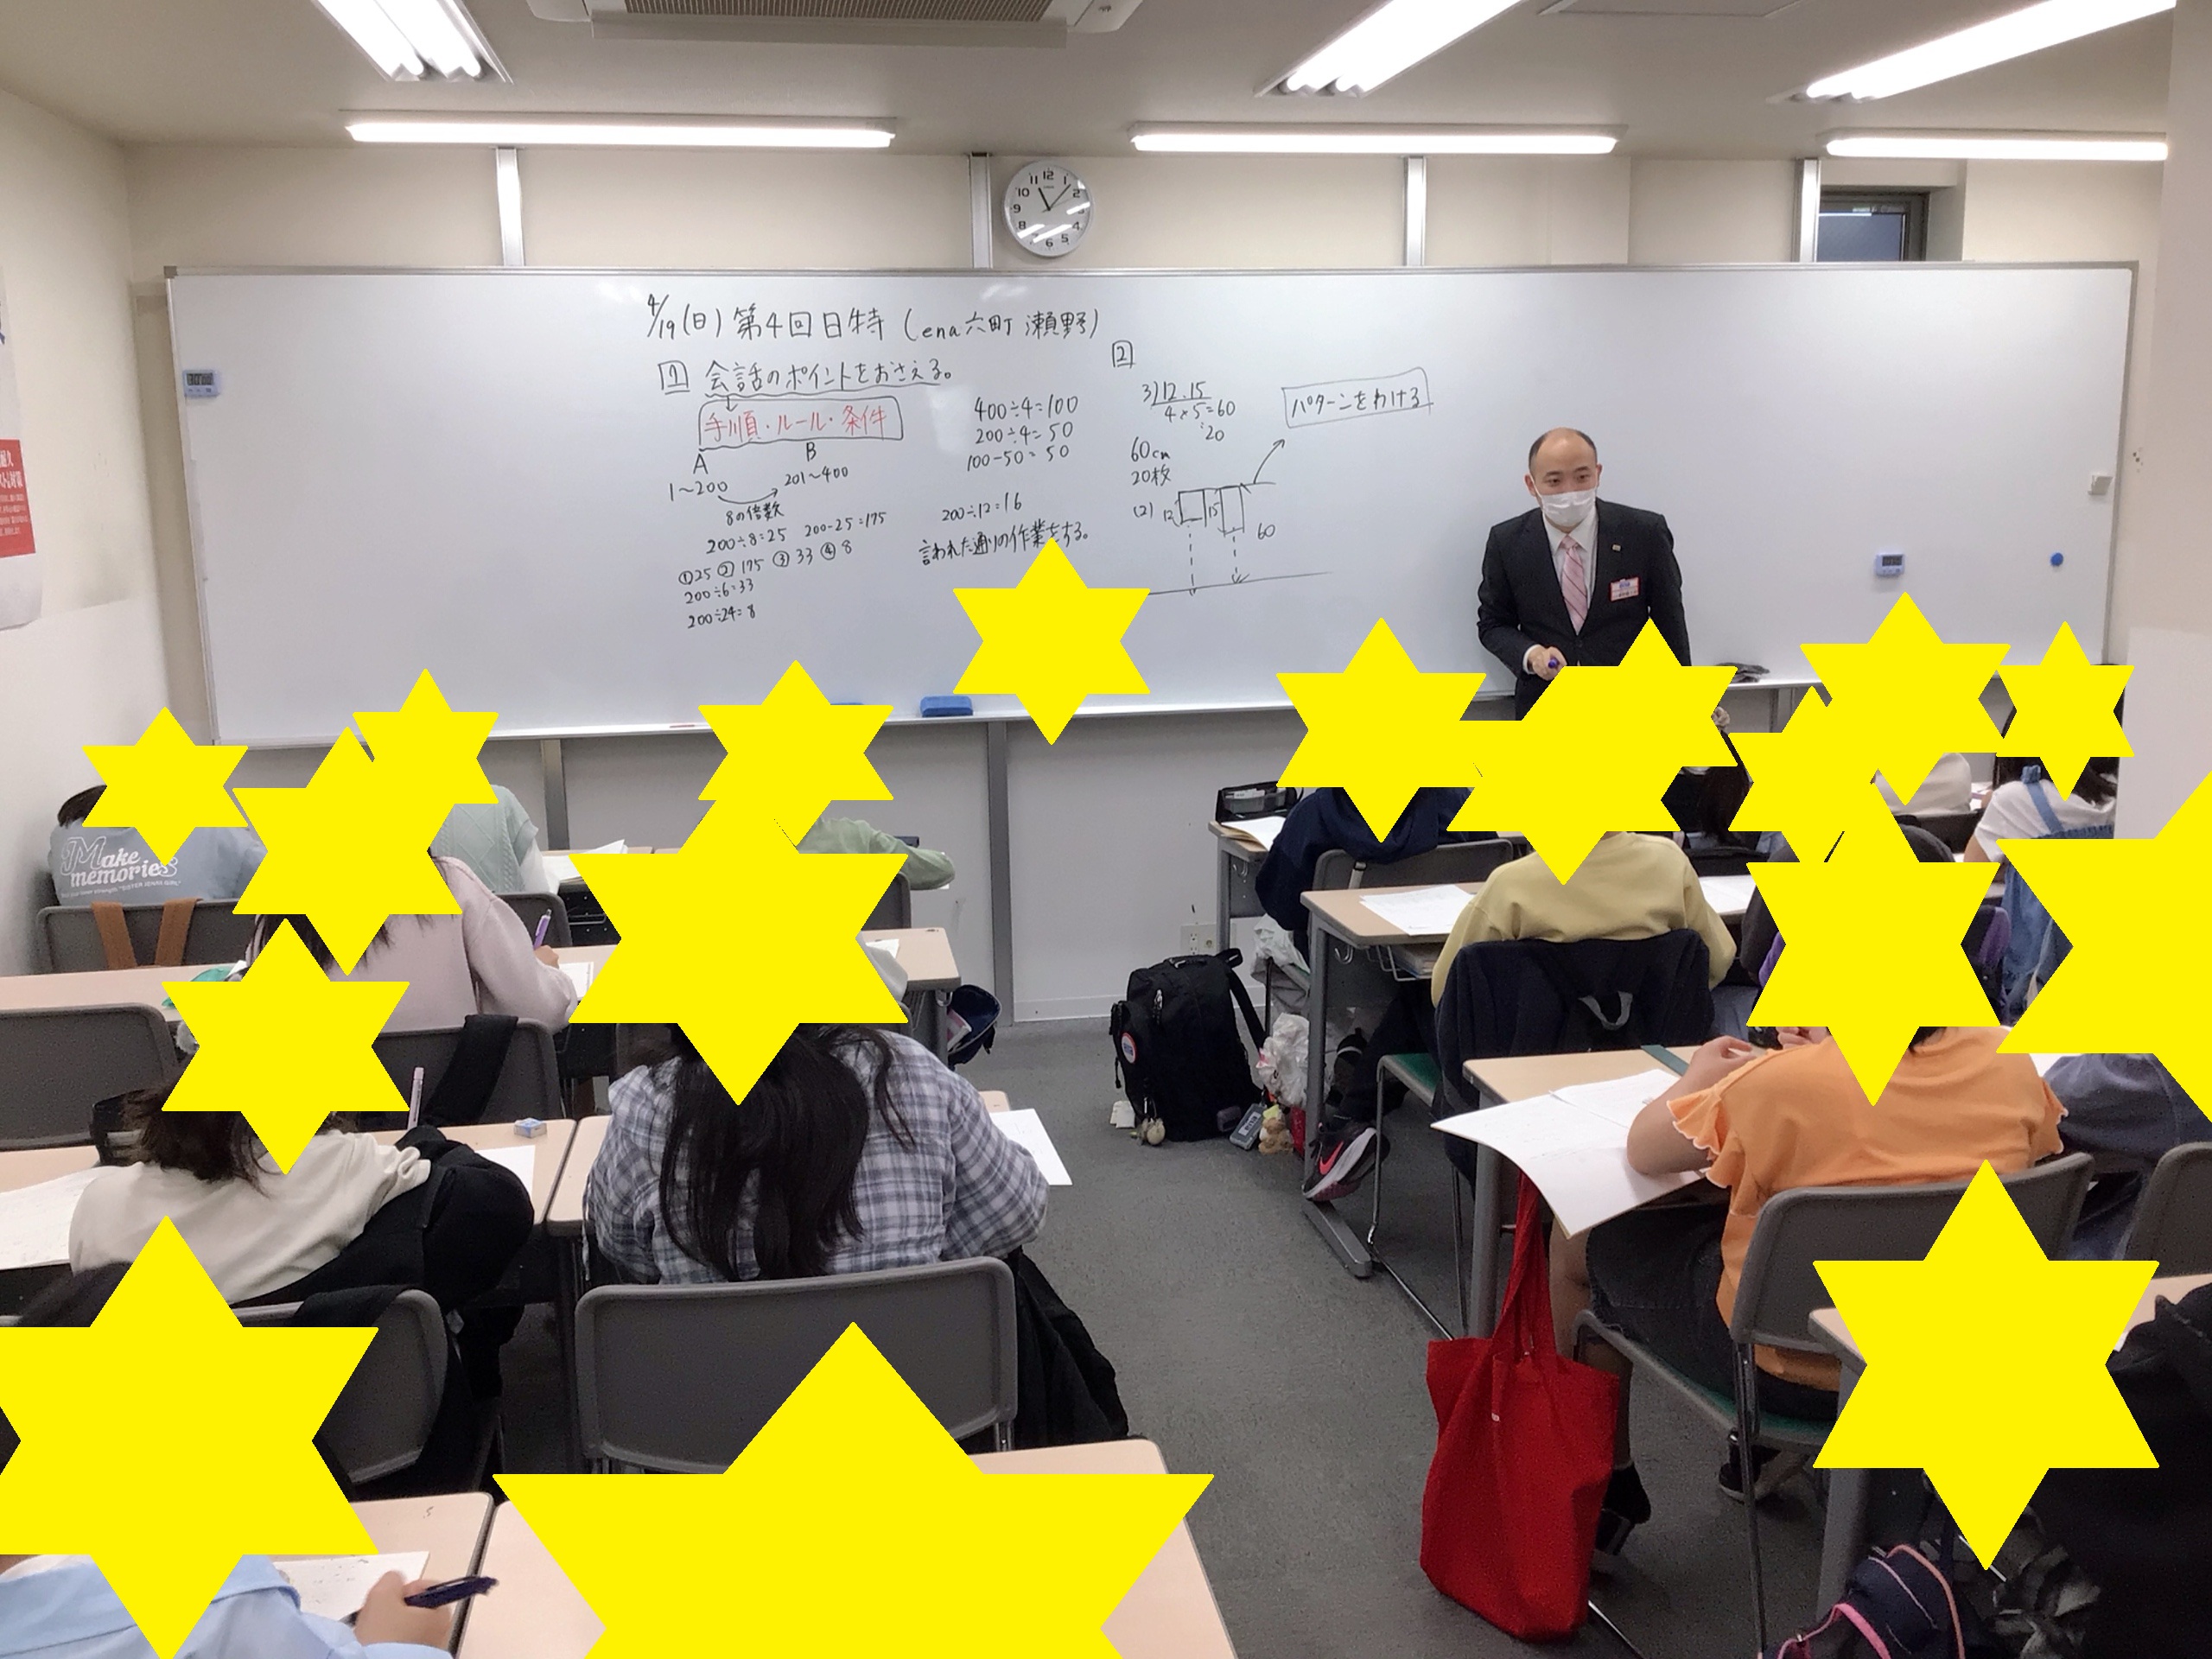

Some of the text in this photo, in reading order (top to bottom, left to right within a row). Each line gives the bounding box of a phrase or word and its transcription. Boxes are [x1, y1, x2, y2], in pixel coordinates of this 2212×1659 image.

[1030, 175, 1038, 184] 11
[1043, 170, 1054, 181] 12
[1063, 175, 1067, 185] 1
[1018, 188, 1030, 198] 10
[1072, 188, 1081, 199] 2
[1013, 204, 1021, 213] 9
[1018, 220, 1027, 231] 8
[1072, 221, 1080, 232] 4
[1046, 238, 1053, 248] 6
[1061, 233, 1069, 243] 5
[1292, 387, 1421, 418] パターンをわける
[805, 442, 817, 462] B
[692, 453, 709, 475] A
[1257, 522, 1276, 540] 60
[60, 836, 140, 876] Make
[70, 856, 179, 888] memories
